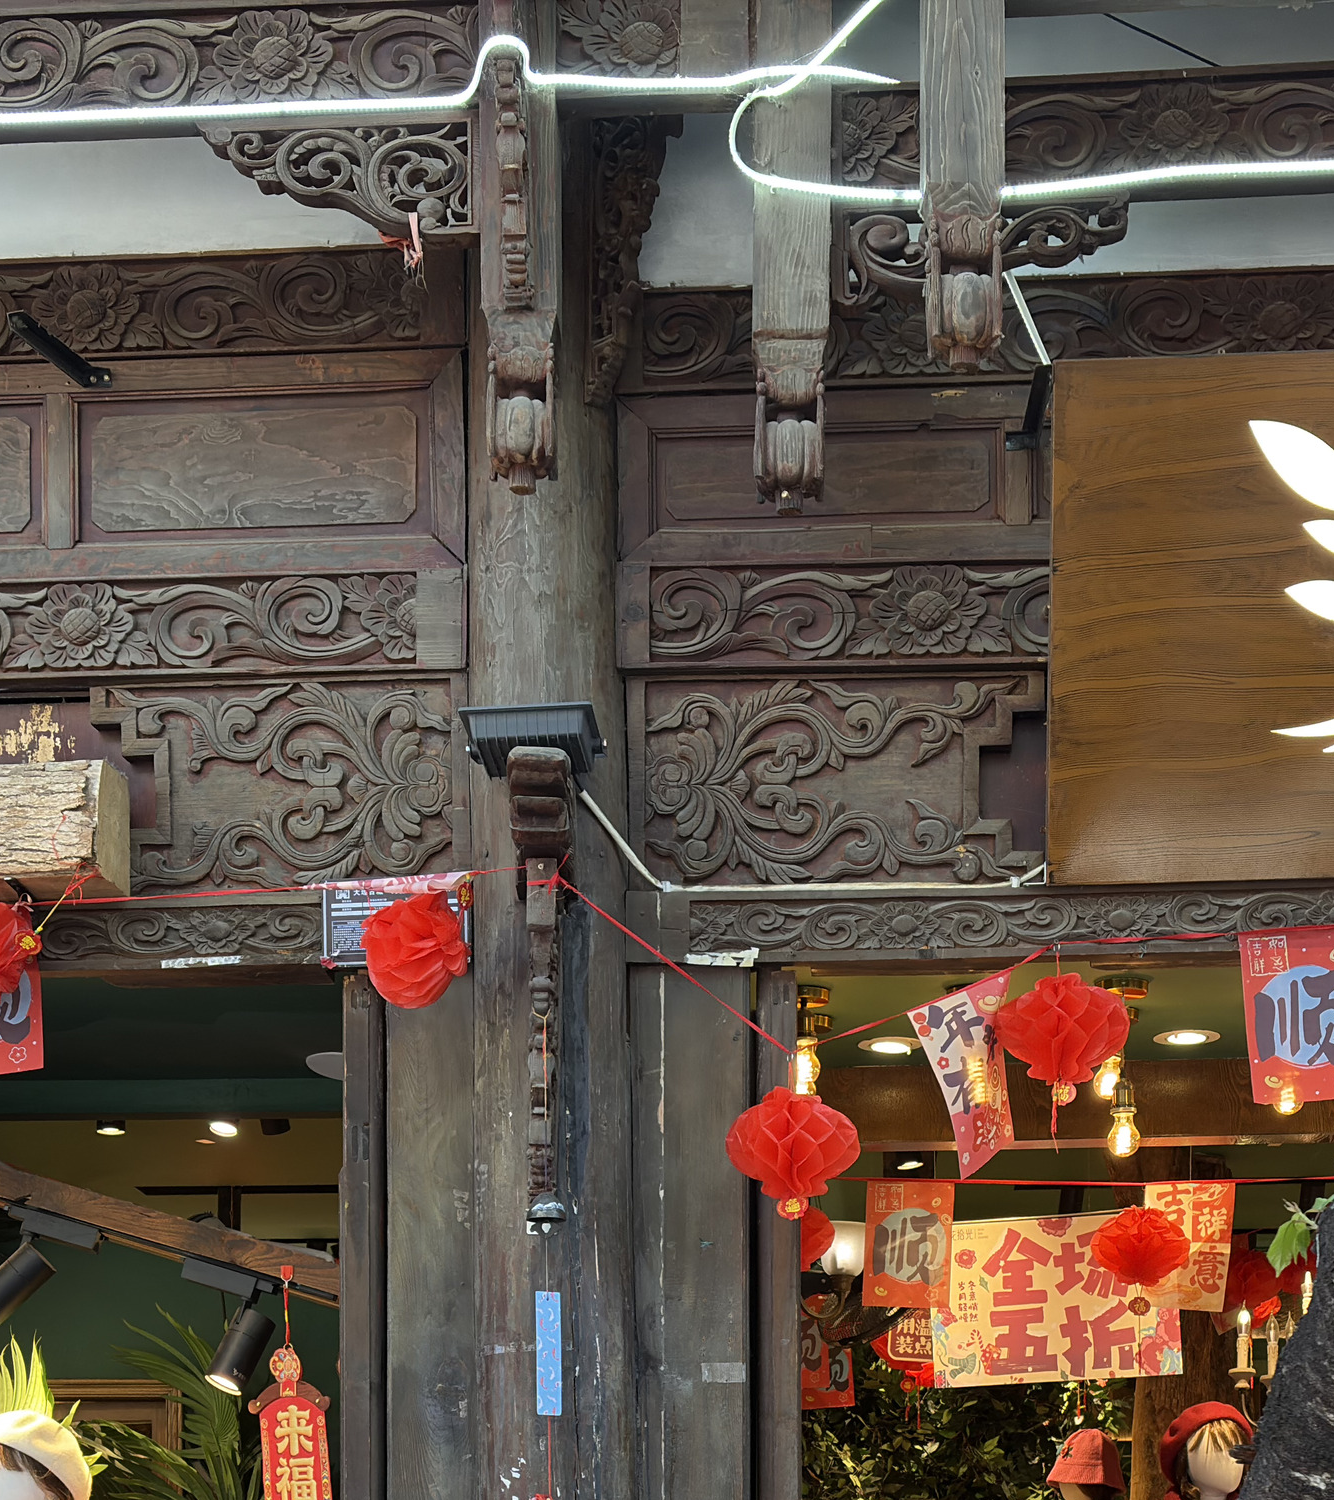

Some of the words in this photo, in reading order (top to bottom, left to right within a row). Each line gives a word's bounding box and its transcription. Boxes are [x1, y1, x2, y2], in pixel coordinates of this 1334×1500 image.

[872, 1213, 945, 1287] 顺
[981, 1227, 1129, 1308] 全场
[989, 1298, 1137, 1378] 五折
